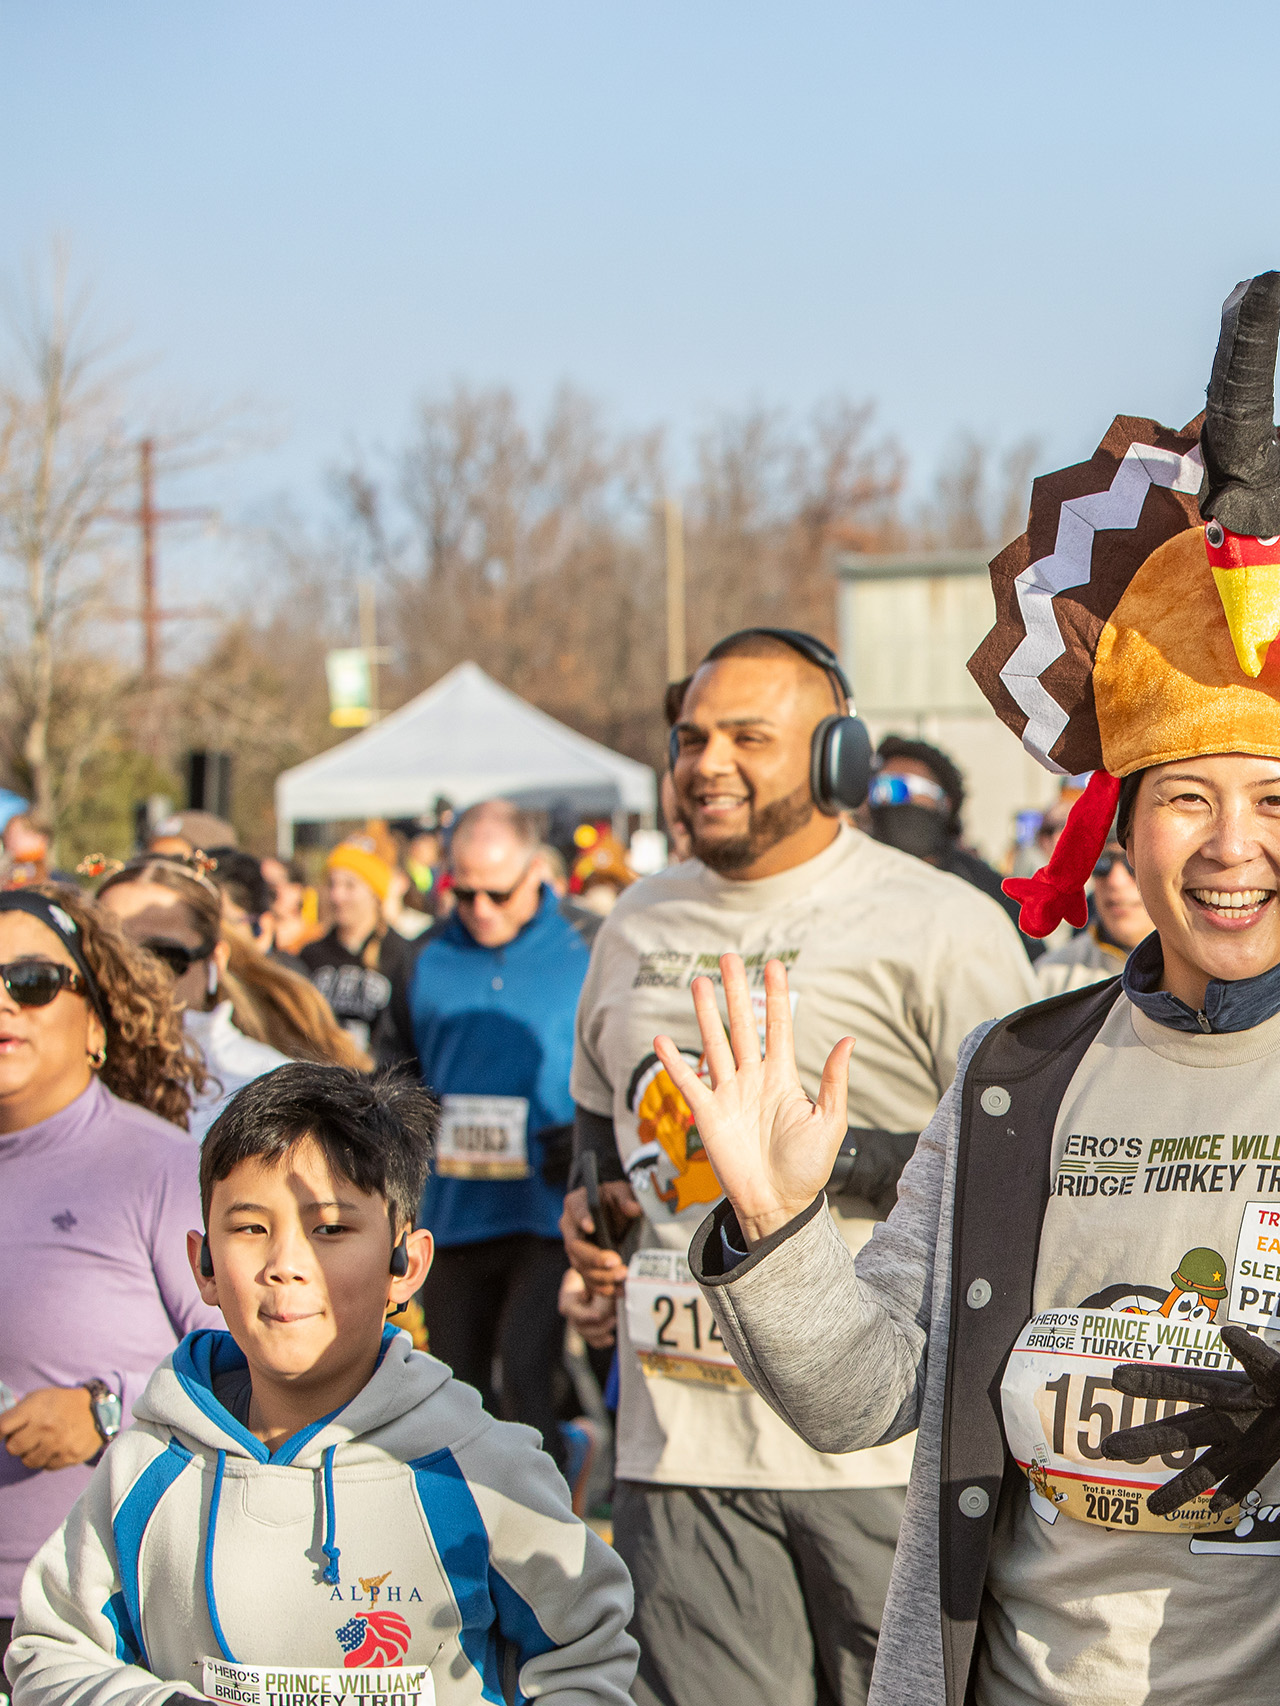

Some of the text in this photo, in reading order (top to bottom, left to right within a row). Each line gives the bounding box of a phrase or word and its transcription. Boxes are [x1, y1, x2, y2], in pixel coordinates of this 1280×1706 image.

[1065, 1134, 1143, 1158] ERO'S
[1147, 1134, 1225, 1164] PRINCE
[1050, 1174, 1136, 1197] RIDGE
[1143, 1164, 1246, 1194] TURKEY
[1035, 1313, 1079, 1326] HERO'S
[1026, 1334, 1075, 1350] BRIDGE
[1081, 1315, 1229, 1352] PRINCE WILLIA
[1081, 1337, 1235, 1371] TURKEY TROT
[1085, 1493, 1139, 1526] 2025
[329, 1585, 424, 1602] ALPHA
[214, 1664, 260, 1683] HERO'S
[265, 1672, 421, 1694] PRINCE WILLIAM
[215, 1684, 260, 1704] BRIDGE
[266, 1691, 422, 1706] TURKEY TROT
